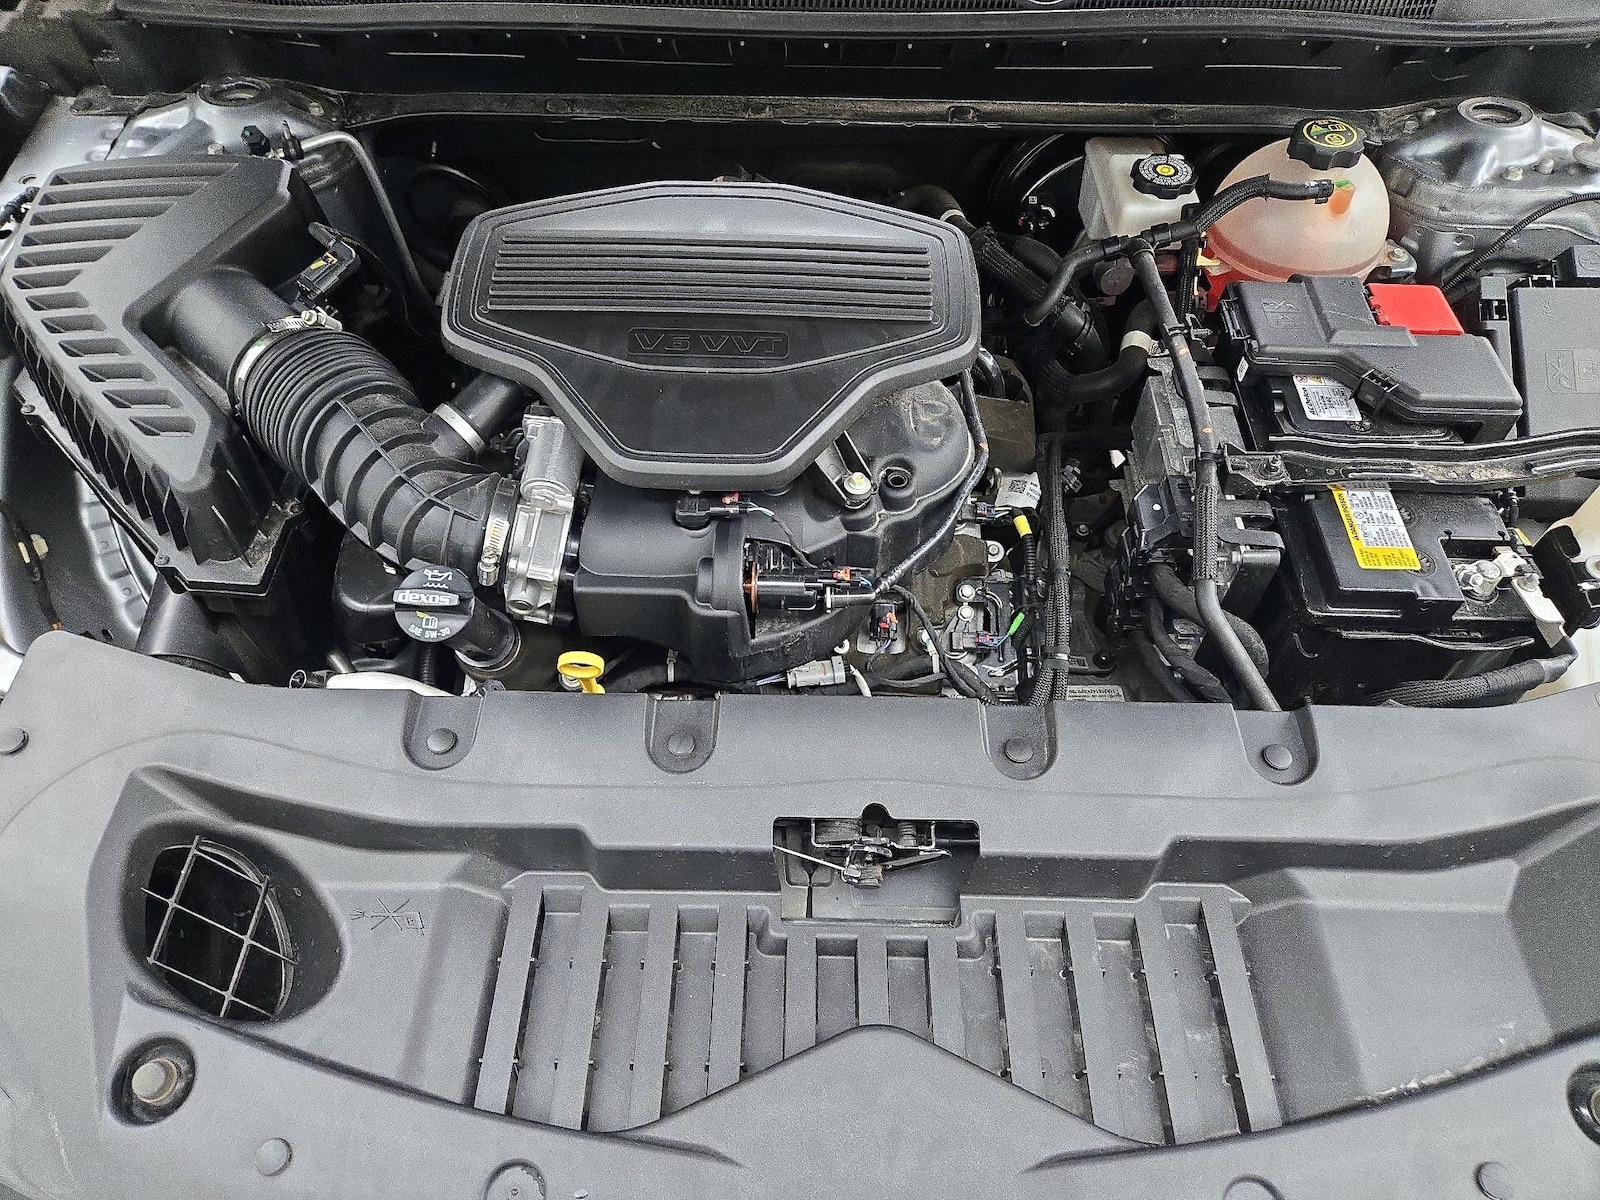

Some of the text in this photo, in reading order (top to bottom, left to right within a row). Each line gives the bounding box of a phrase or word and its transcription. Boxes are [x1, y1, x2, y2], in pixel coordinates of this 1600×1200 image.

[634, 333, 783, 353] V6 VVT
[398, 589, 450, 604] dexos
[408, 624, 451, 639] SAE 5W-30
